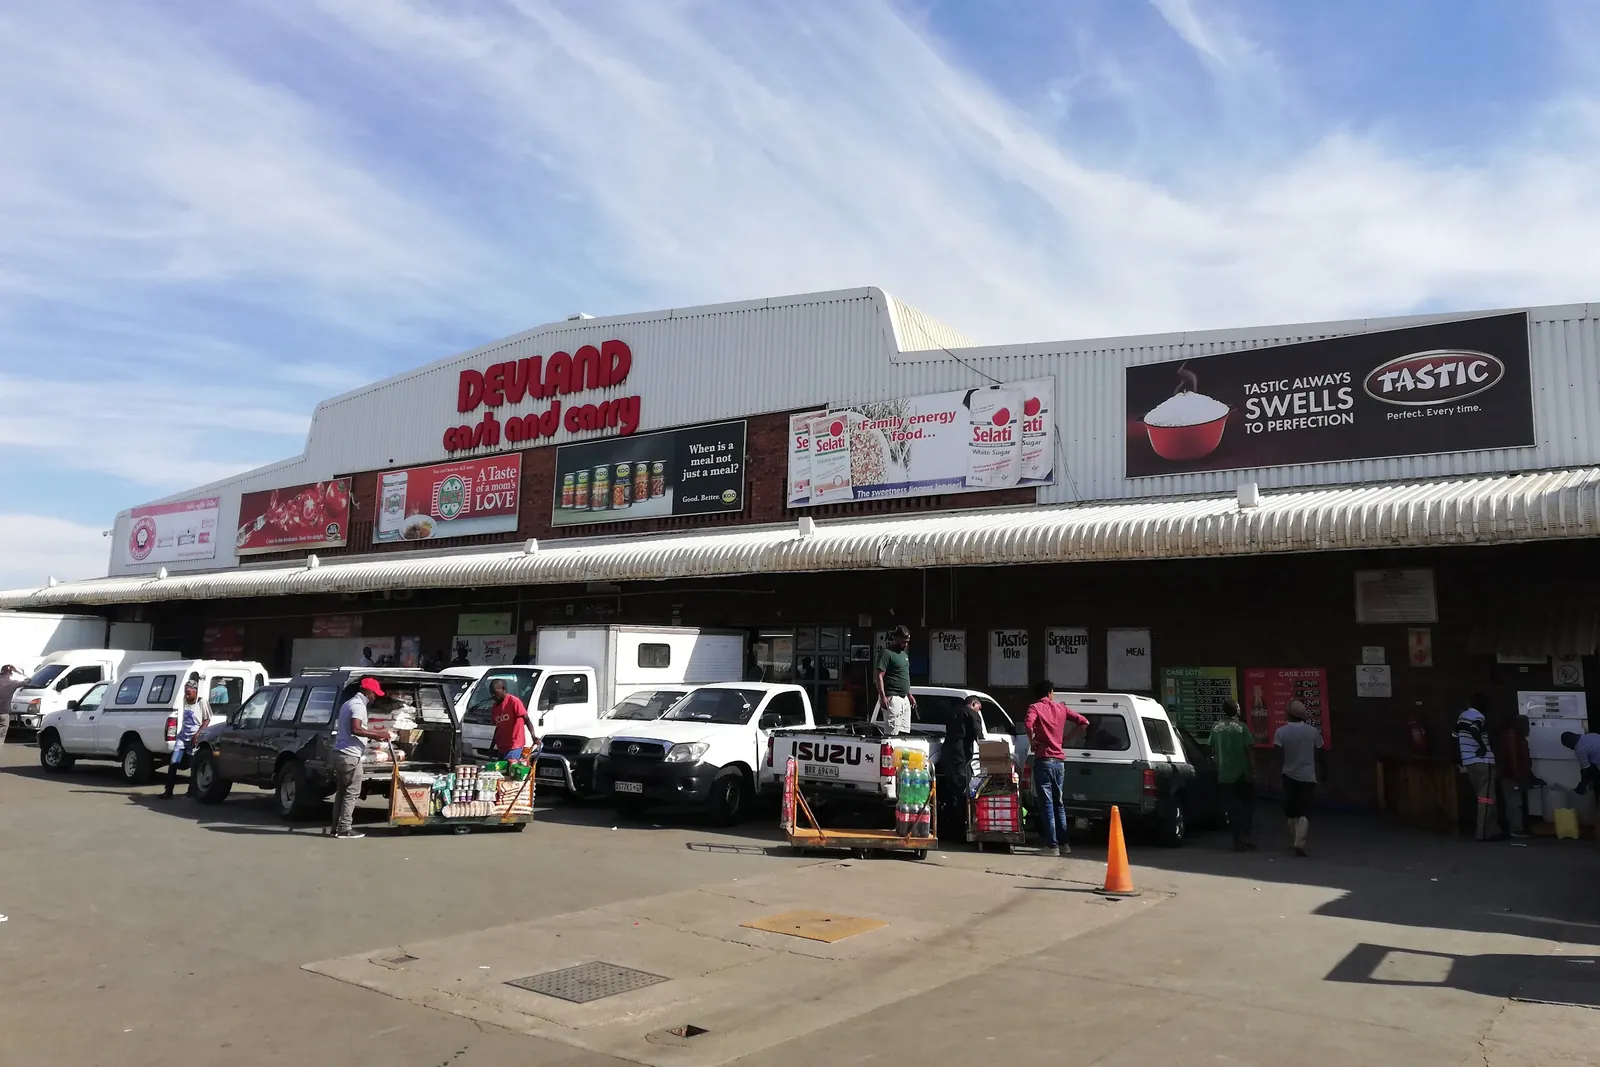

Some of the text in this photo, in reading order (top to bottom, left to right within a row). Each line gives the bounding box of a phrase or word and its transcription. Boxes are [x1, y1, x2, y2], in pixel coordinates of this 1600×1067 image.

[457, 339, 632, 413] DEVLAND
[1243, 371, 1352, 395] TASTIC ALWAYS
[1377, 358, 1490, 394] TASTIC
[1245, 387, 1354, 421] SWELLS
[909, 411, 956, 425] energy
[1386, 404, 1482, 421] Perfect. Every time.
[443, 395, 641, 453] cash and carry
[1022, 416, 1043, 433] ati
[1245, 412, 1354, 434] TO PERFECTION
[973, 426, 1012, 442] Selati
[688, 442, 734, 455] When is a
[816, 436, 845, 453] Selati
[1022, 439, 1041, 447] Sugar
[690, 453, 732, 466] meal not
[992, 449, 1011, 457] Sugar
[477, 466, 517, 482] A Taste
[682, 462, 739, 481] just a meal?
[476, 484, 485, 493] of
[491, 479, 516, 490] mom's
[857, 489, 870, 499] The
[871, 486, 907, 498] sweetness
[475, 491, 515, 511] LOVE
[682, 493, 720, 504] Good. Better.
[939, 631, 957, 643] PAPA
[1048, 632, 1088, 646] SPARLETTA
[1126, 648, 1146, 656] MEAL
[792, 741, 861, 765] ISUZU
